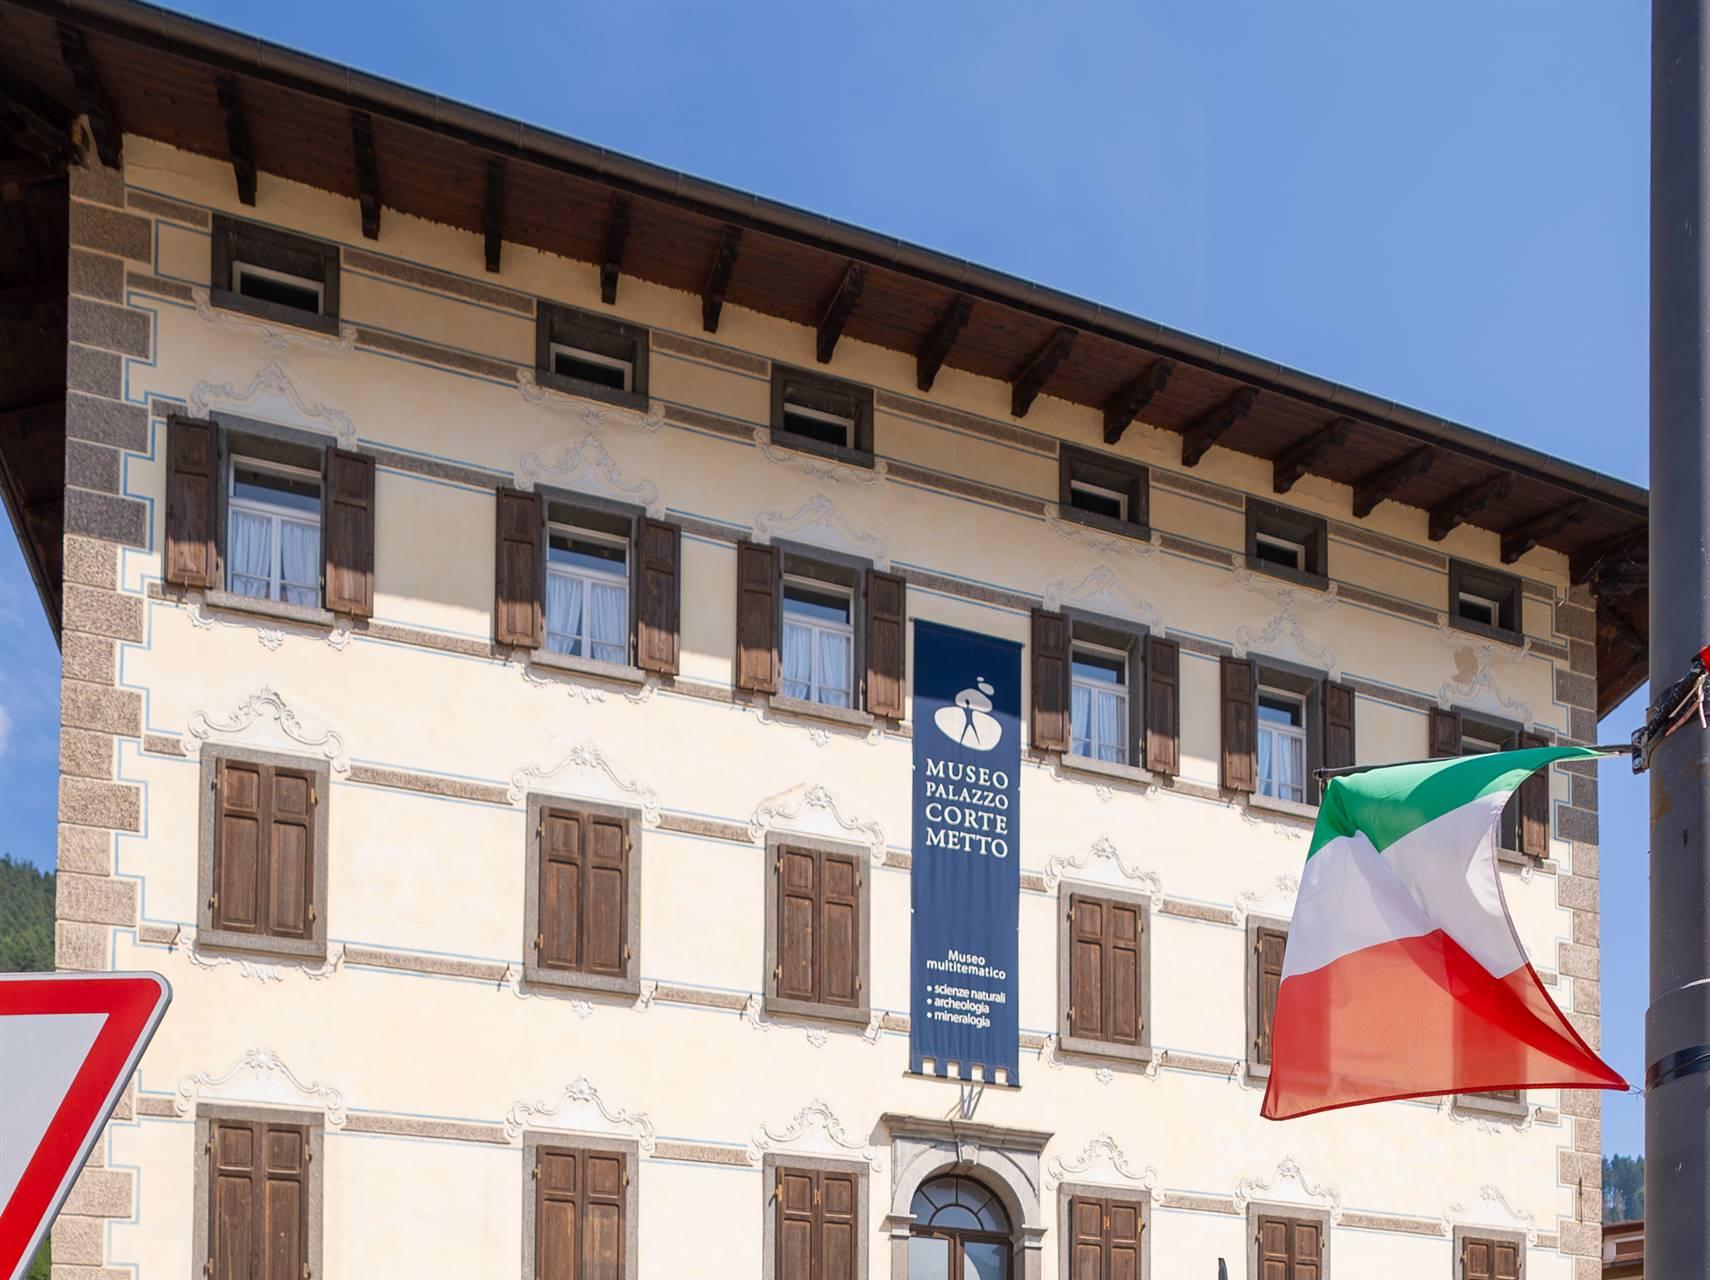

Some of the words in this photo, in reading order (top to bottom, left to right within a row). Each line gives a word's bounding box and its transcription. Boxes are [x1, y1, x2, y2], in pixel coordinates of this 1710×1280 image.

[925, 758, 1009, 789] MUSEO
[926, 781, 1009, 810] PALAZZO
[925, 803, 1008, 835] CORTE
[925, 827, 1008, 858] METTO
[948, 949, 986, 965] Museo
[926, 959, 1006, 980] multitematico
[934, 984, 970, 998] scienze
[970, 989, 1006, 1004] naturali
[934, 997, 990, 1015] archeologia
[934, 1010, 991, 1029] mineralogia
